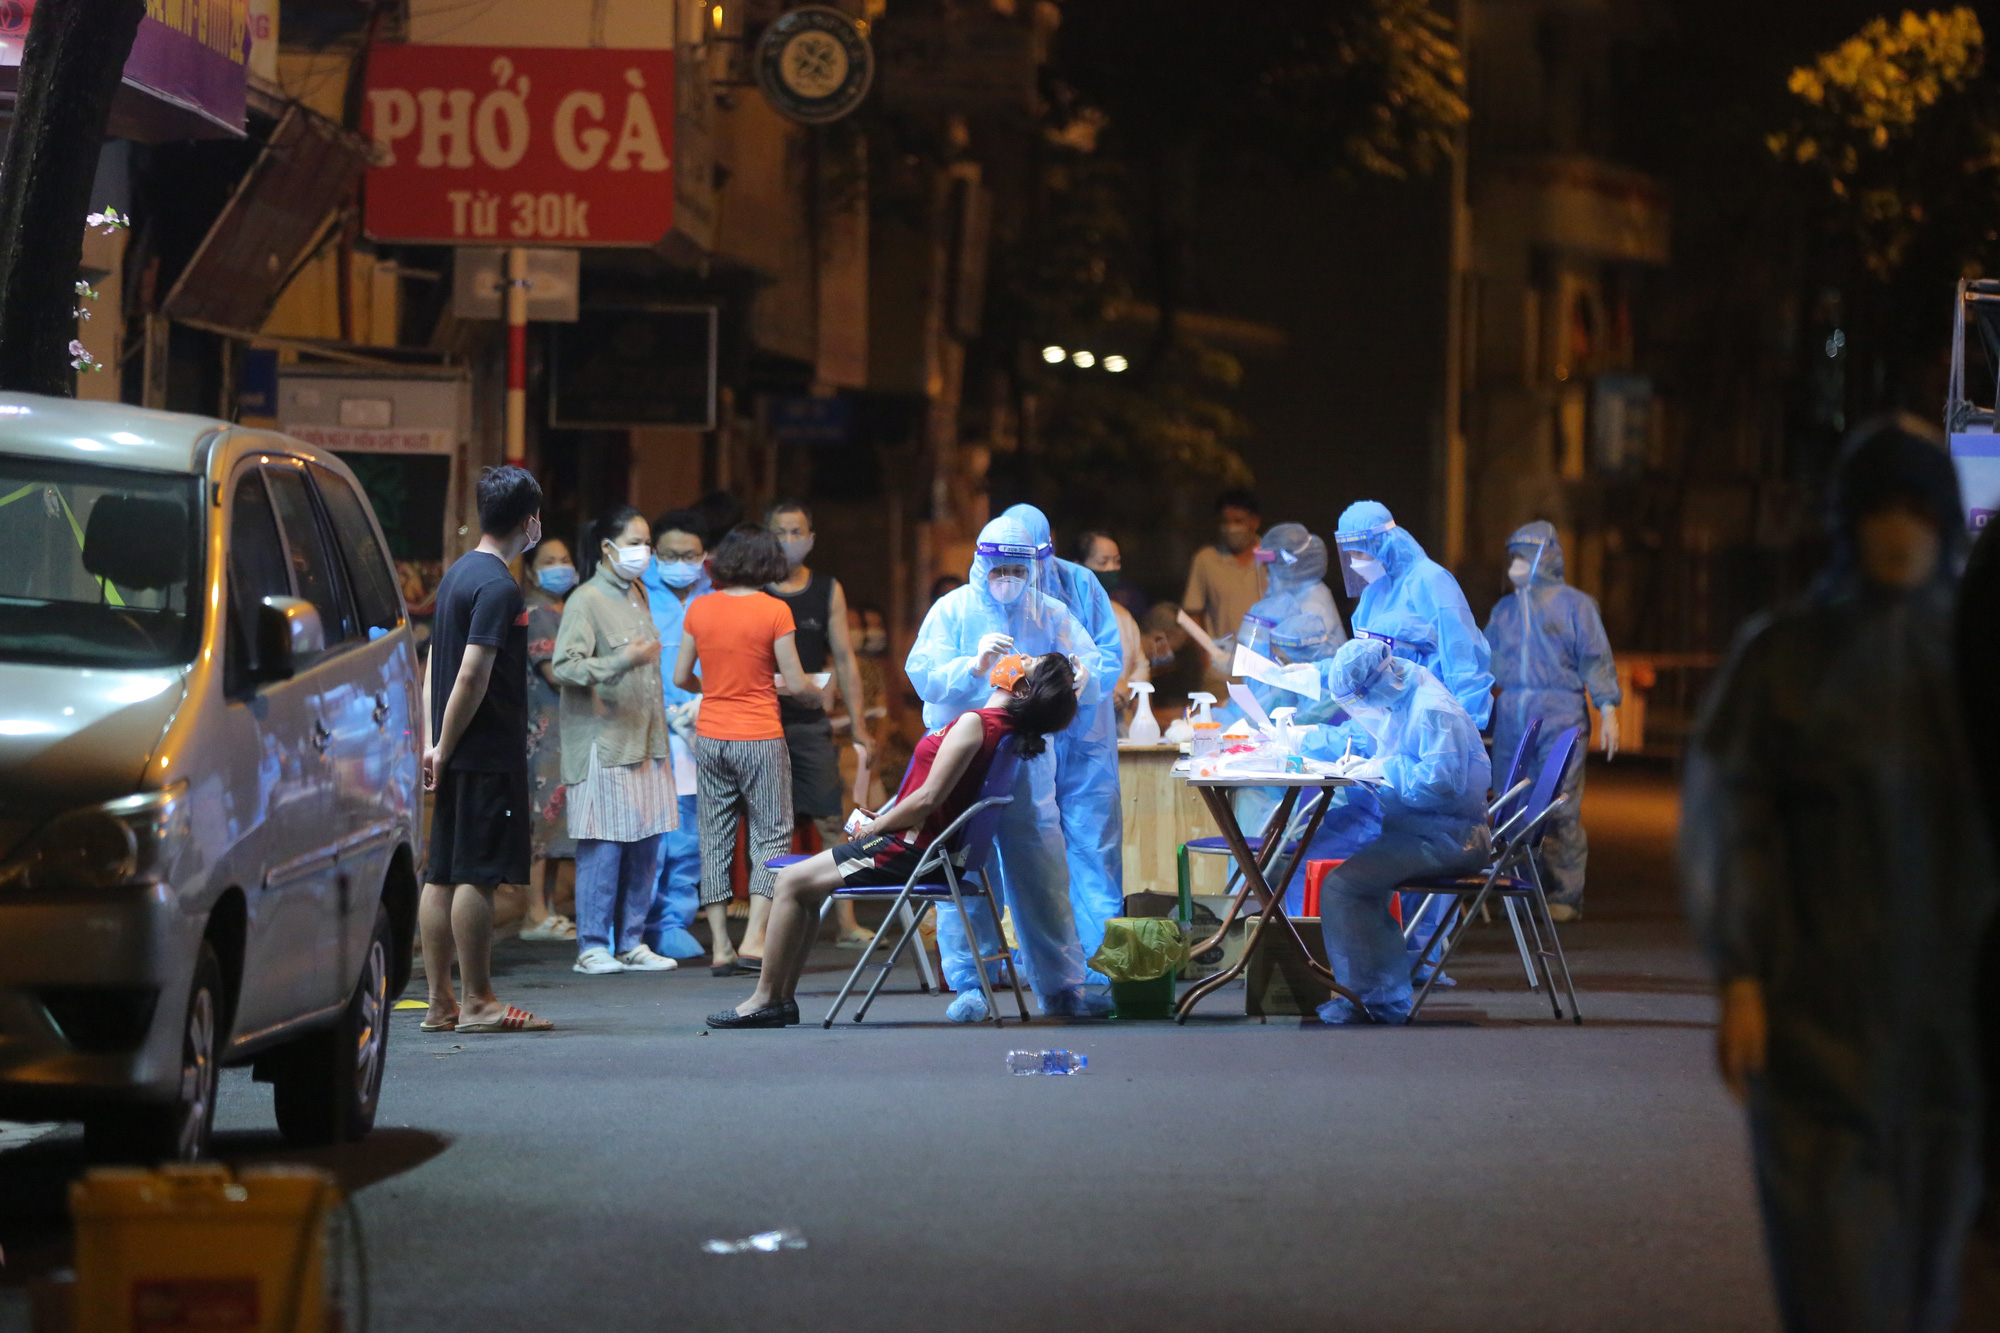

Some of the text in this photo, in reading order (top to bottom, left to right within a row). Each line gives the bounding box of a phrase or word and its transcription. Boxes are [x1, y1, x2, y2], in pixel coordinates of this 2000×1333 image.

[367, 56, 670, 171] PHỞ GÀ
[447, 189, 589, 238] Từ 30k
